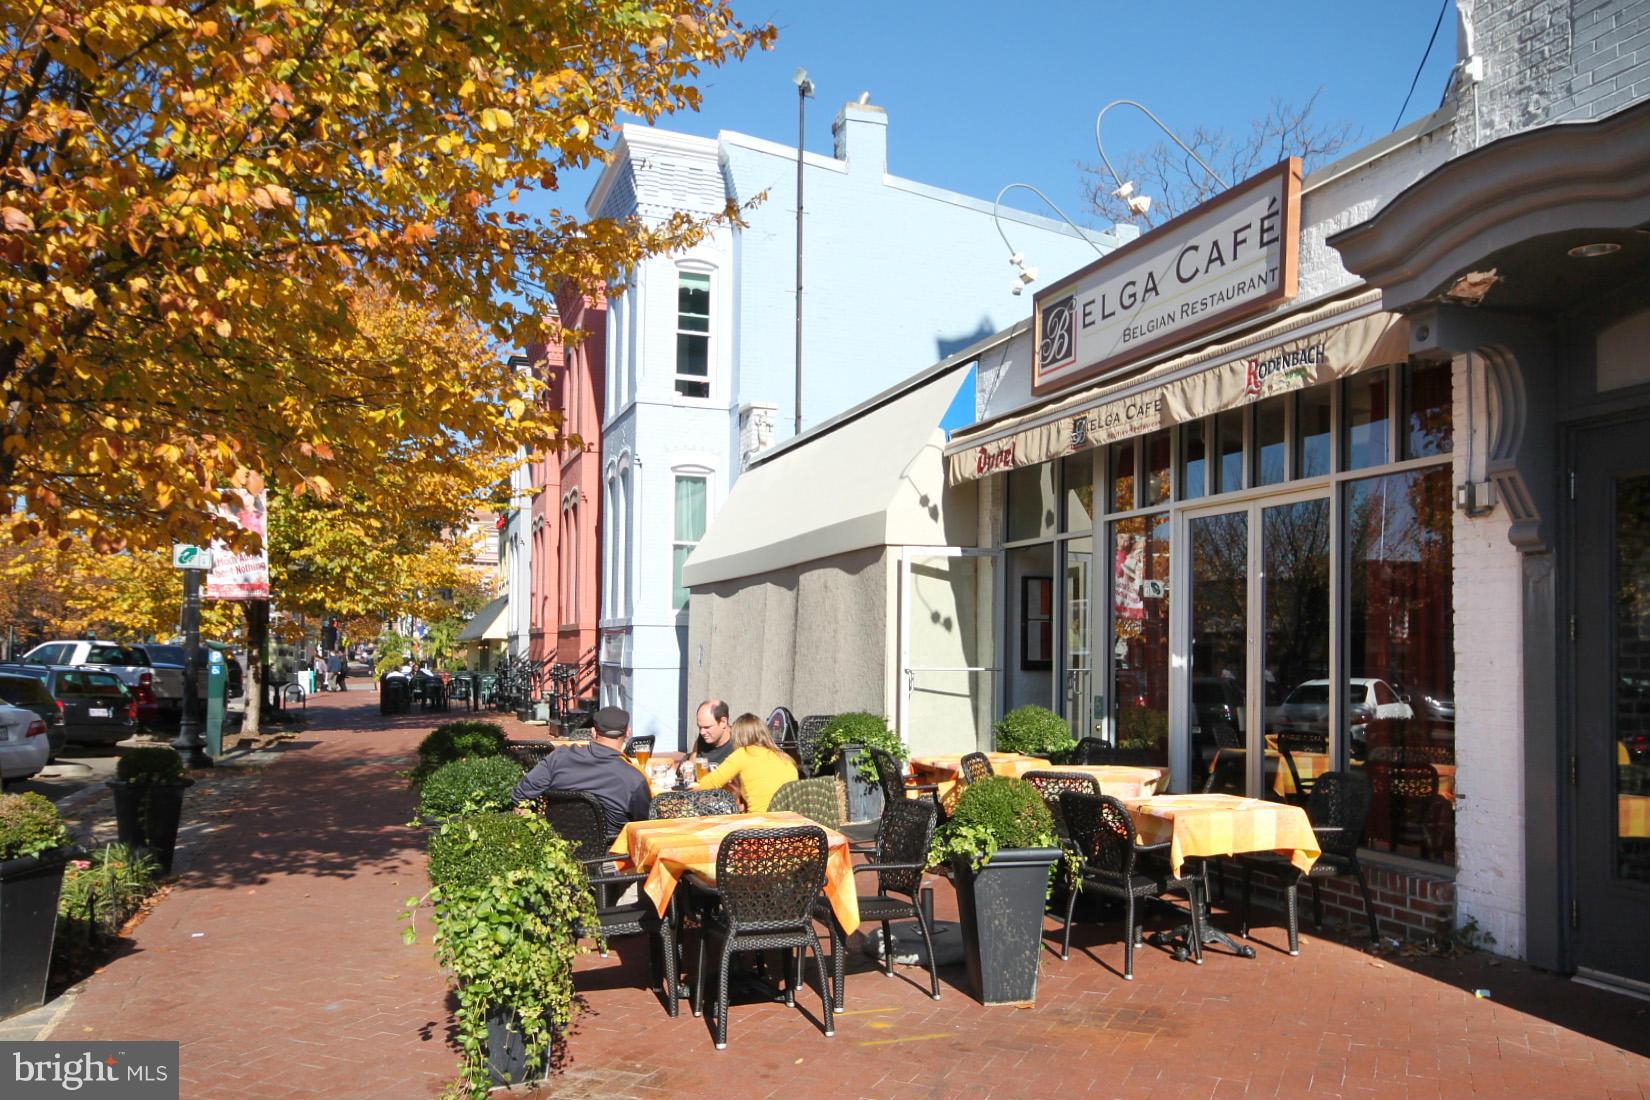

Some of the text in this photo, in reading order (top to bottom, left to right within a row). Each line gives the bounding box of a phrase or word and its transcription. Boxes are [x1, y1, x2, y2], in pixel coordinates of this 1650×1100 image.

[1175, 197, 1280, 284] CAFÉ
[1122, 266, 1279, 343] BELGIAN RESTAURANT
[1246, 343, 1326, 394] RODENBACH
